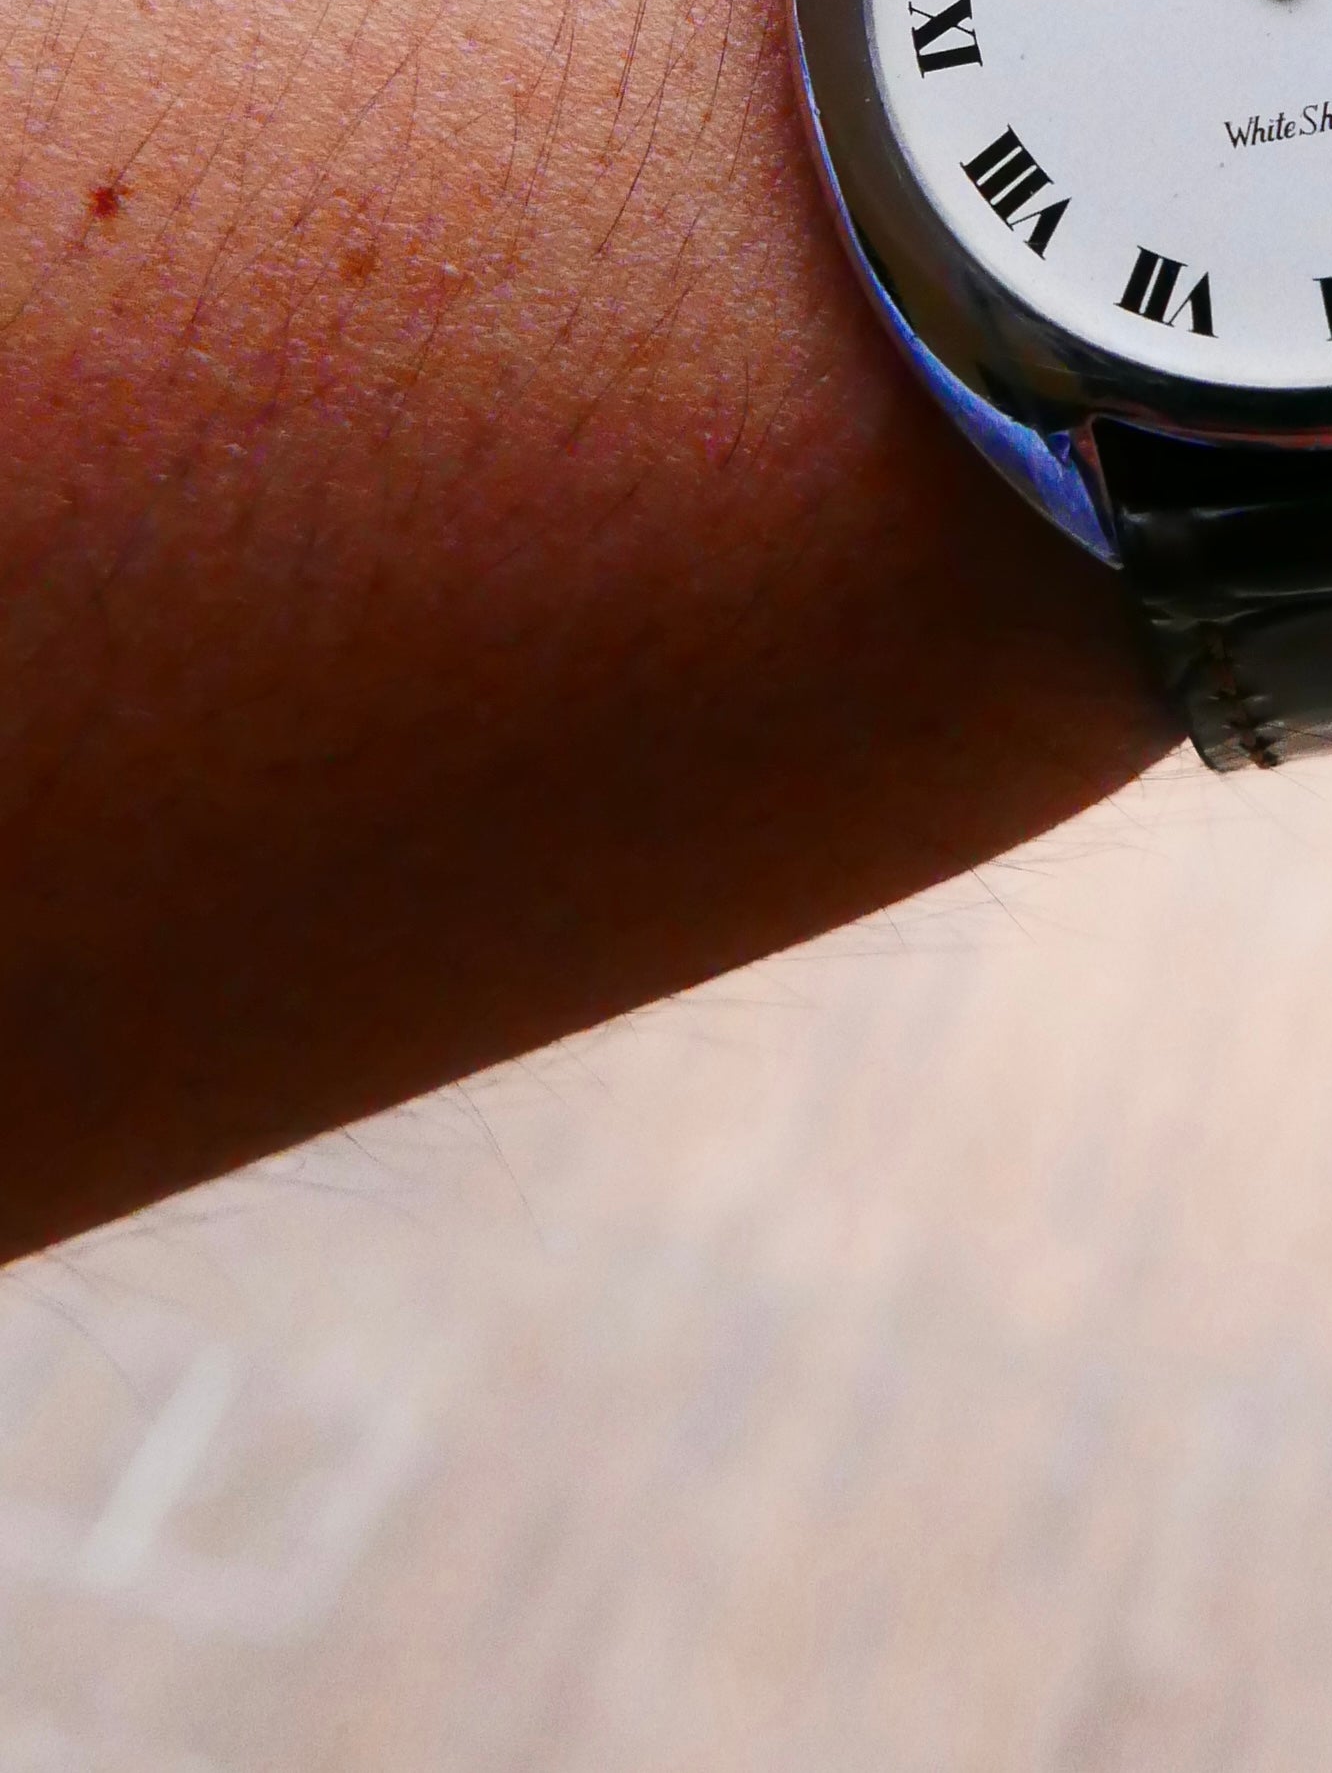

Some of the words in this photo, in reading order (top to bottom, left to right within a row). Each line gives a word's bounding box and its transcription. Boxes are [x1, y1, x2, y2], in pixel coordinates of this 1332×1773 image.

[1224, 112, 1297, 149] White
[959, 125, 1072, 260] VIII
[1113, 245, 1219, 339] VII
